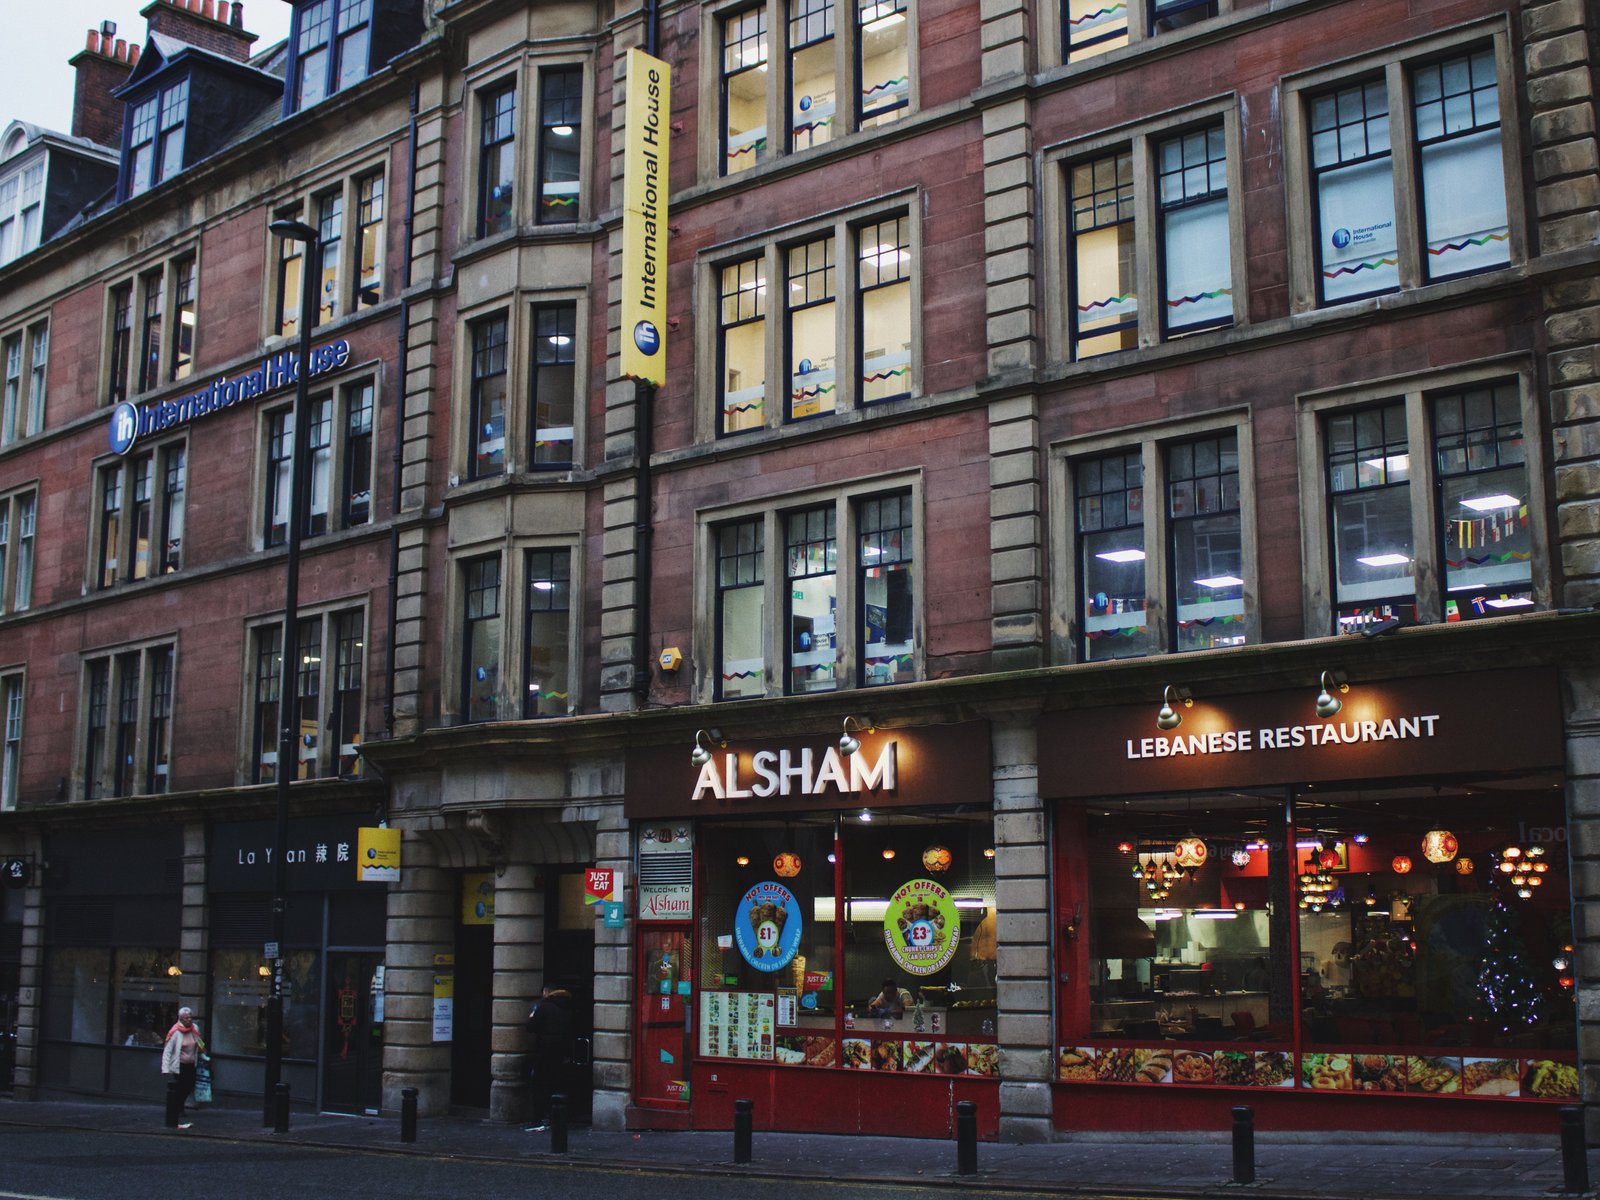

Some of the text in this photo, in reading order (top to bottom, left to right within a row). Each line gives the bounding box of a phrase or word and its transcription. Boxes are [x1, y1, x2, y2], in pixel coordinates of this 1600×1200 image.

[640, 68, 660, 309] International House
[1353, 221, 1392, 234] International
[1353, 233, 1373, 241] House
[639, 322, 655, 344] ih
[138, 360, 271, 436] International
[117, 412, 133, 442] ih
[1127, 715, 1440, 759] LEBANESE RESTAURANT
[691, 741, 898, 800] ALSHAM
[238, 848, 306, 865] La Yan
[590, 872, 610, 882] JUST
[593, 881, 610, 891] EAT
[745, 884, 792, 902] HOT OFFERS
[894, 881, 946, 902] HOT OFFERS
[642, 894, 689, 916] Alsham
